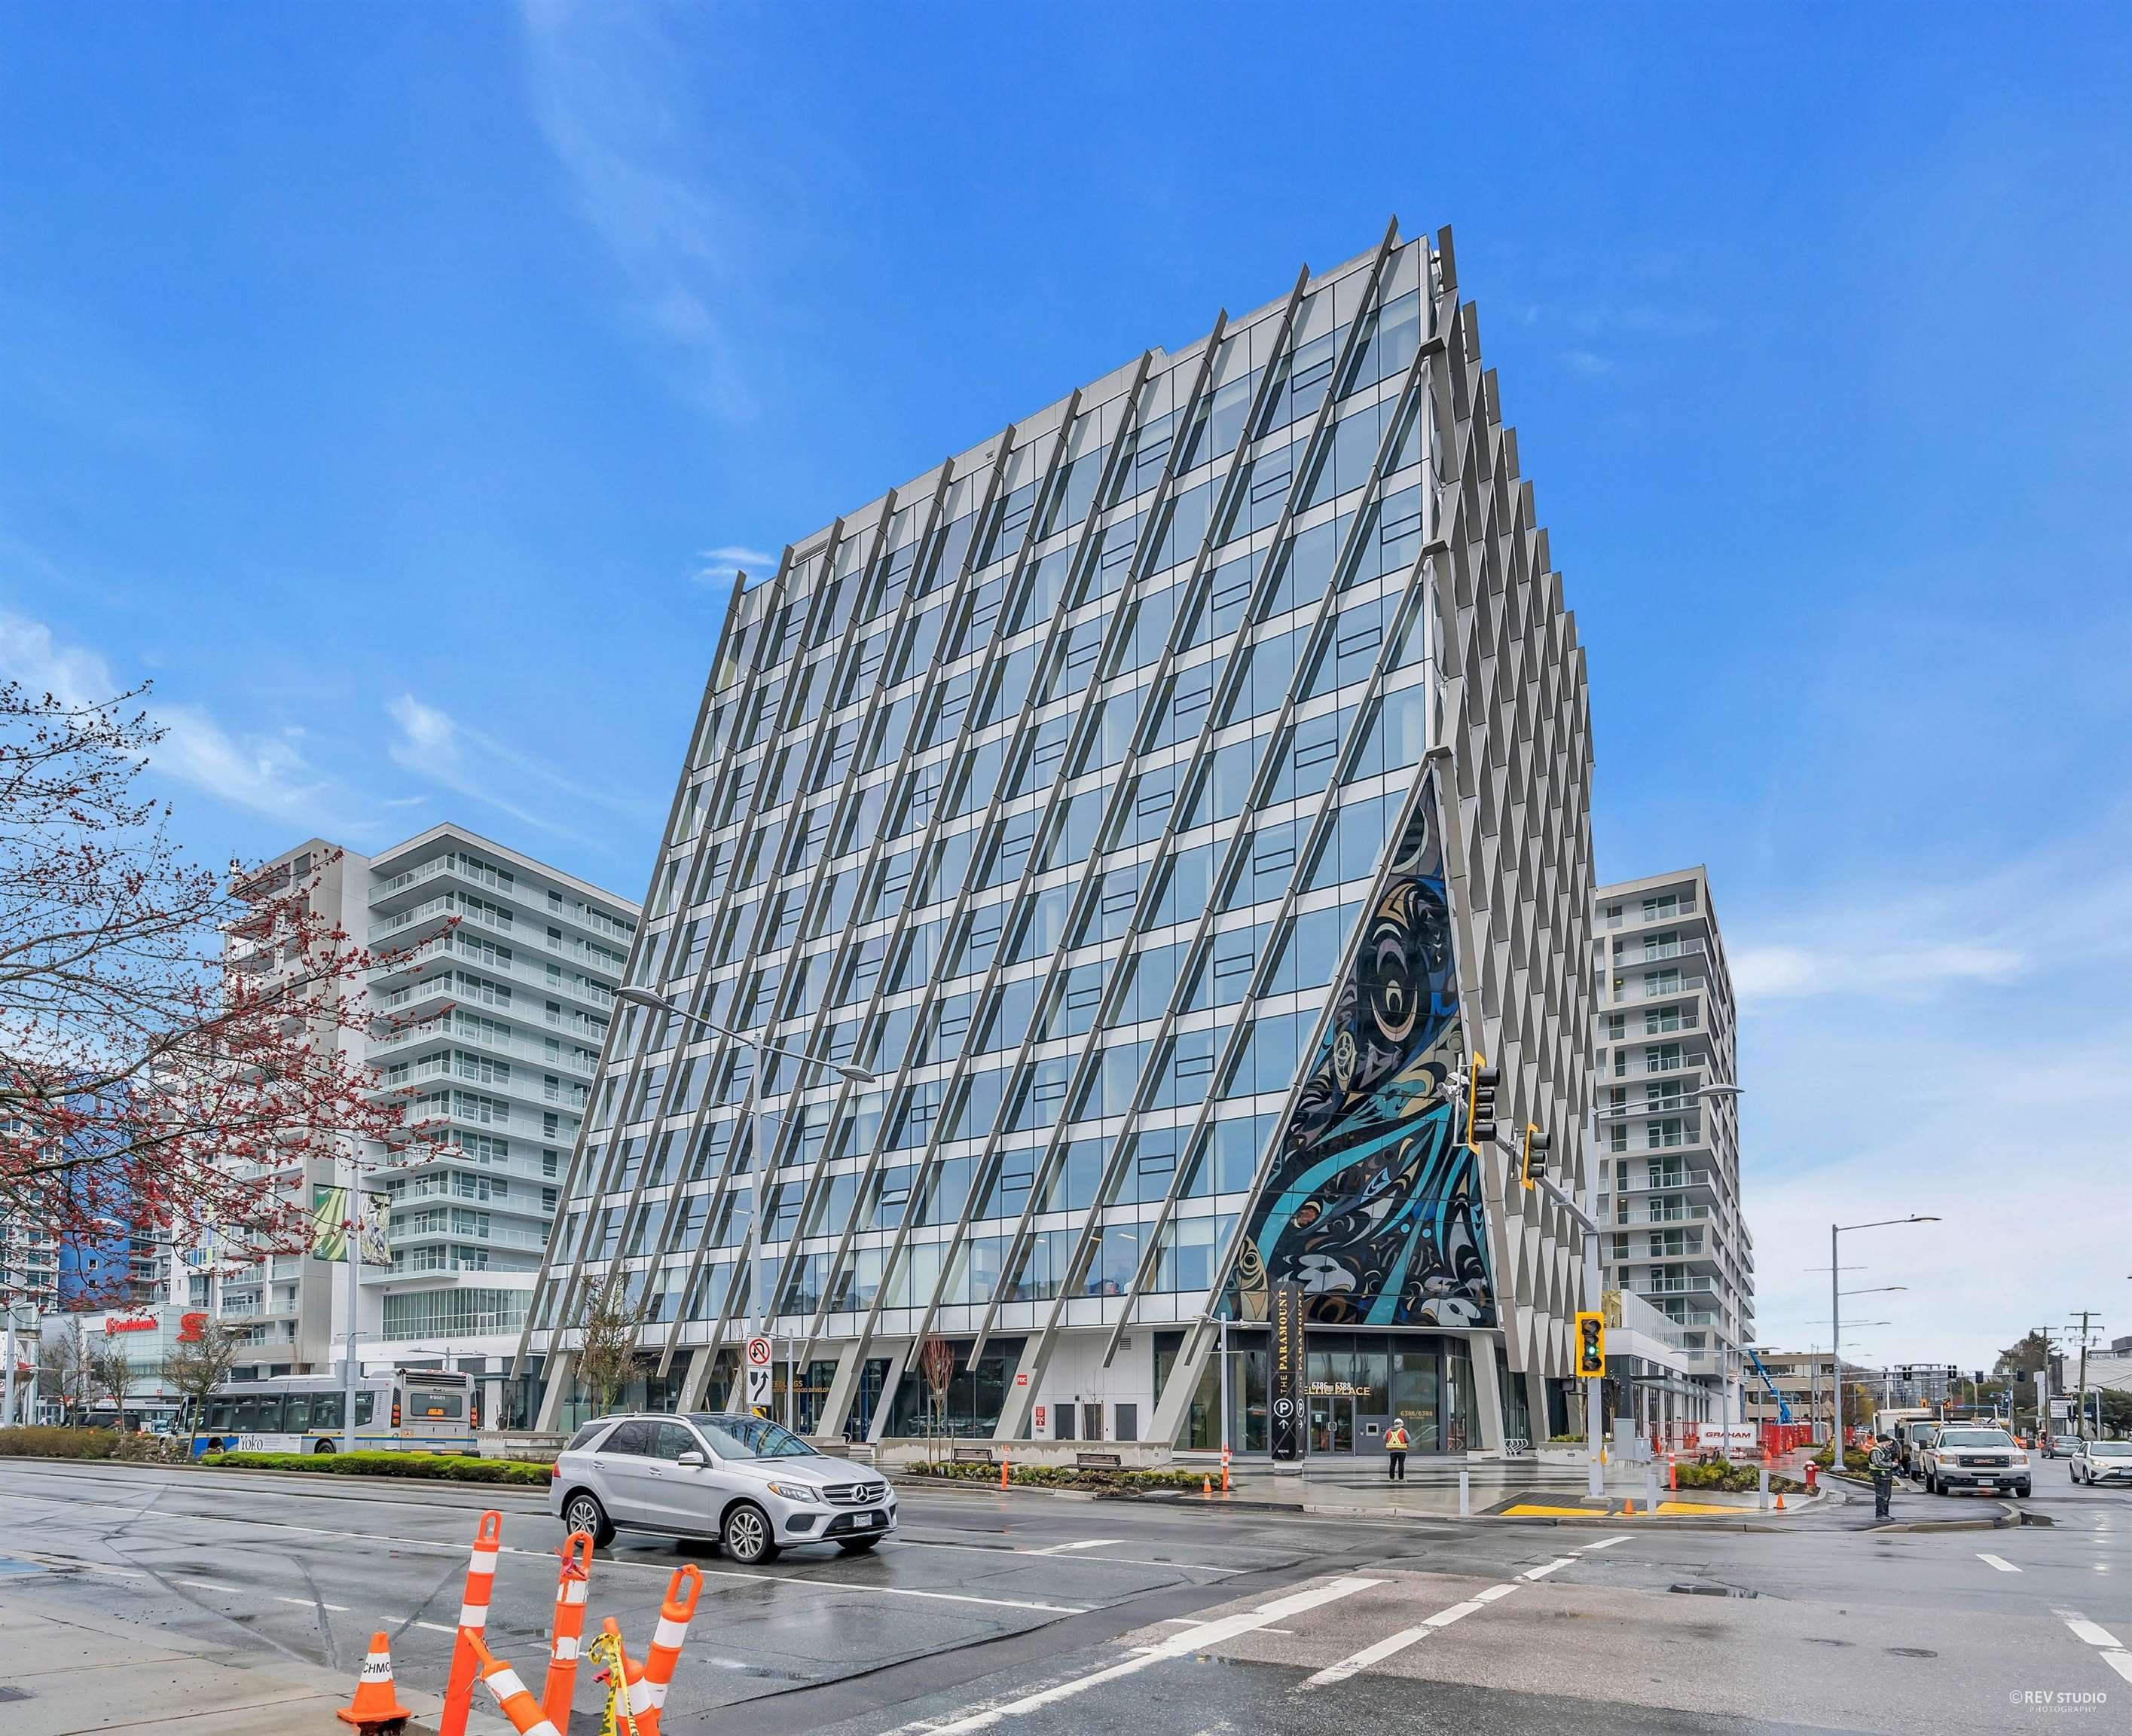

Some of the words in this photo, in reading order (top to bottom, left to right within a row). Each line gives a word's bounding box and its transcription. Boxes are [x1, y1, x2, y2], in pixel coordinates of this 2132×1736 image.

[1278, 1290, 1287, 1371] PARAMOUNT
[1312, 1382, 1327, 1391] 6386
[1335, 1382, 1352, 1391] 6388
[241, 1435, 263, 1450] Yoko
